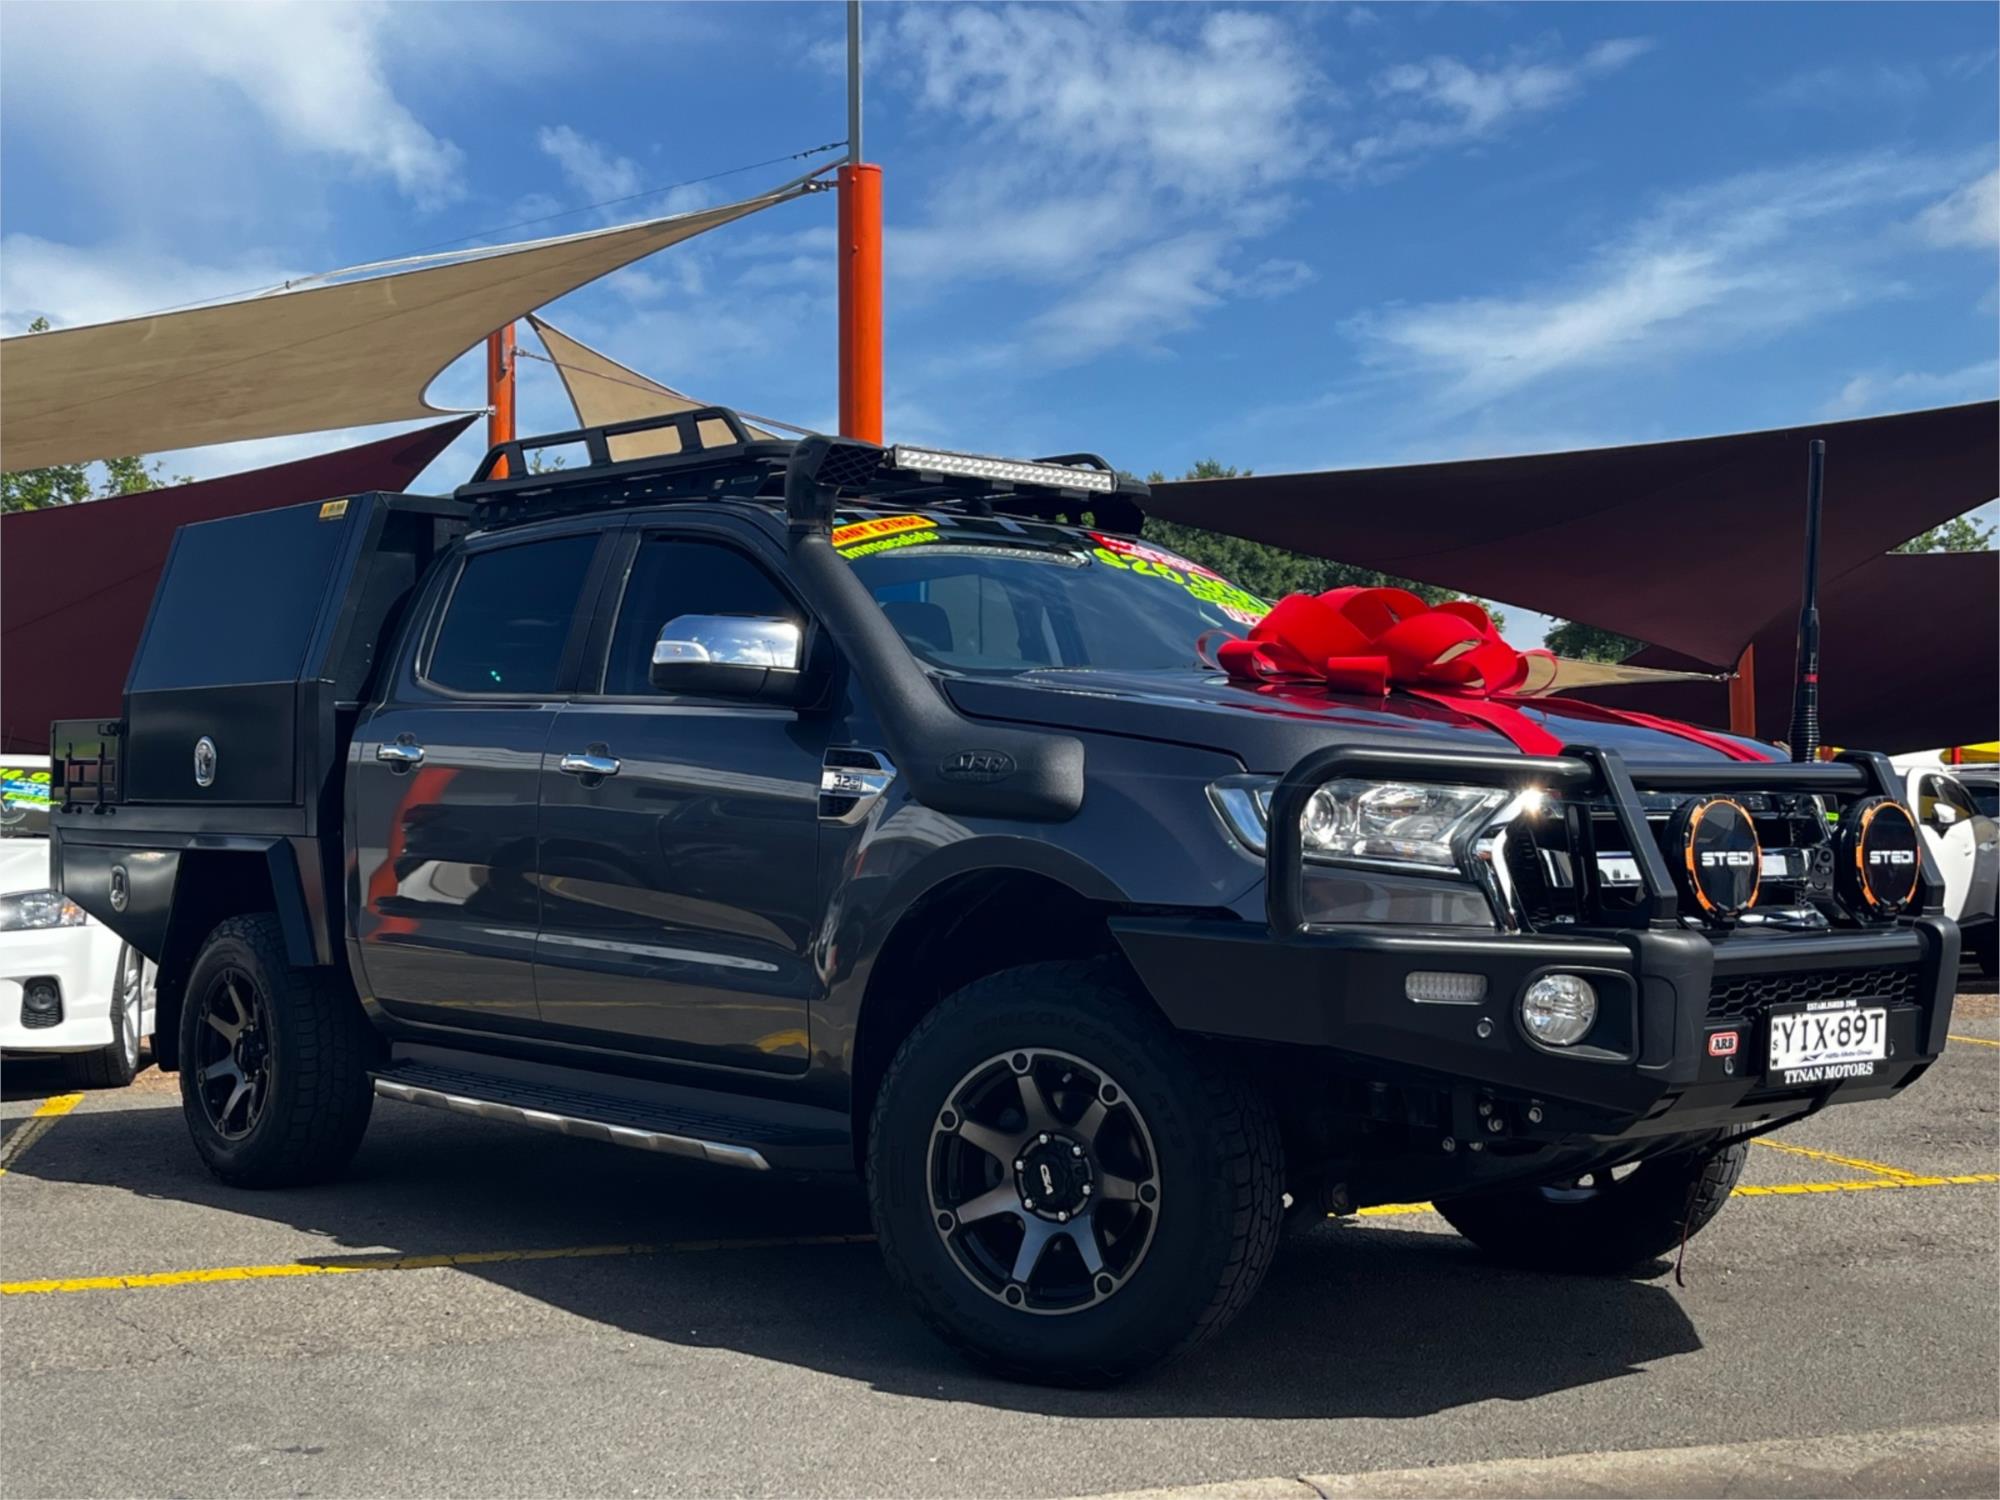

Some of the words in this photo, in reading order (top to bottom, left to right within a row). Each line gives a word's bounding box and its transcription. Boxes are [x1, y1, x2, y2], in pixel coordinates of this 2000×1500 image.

[836, 531, 939, 559] Immaculate
[1701, 851, 1754, 866] STEDI
[1869, 850, 1913, 864] STEDI
[1713, 1037, 1734, 1050] ARB
[1784, 1067, 1823, 1085] TYNAN
[1825, 1062, 1873, 1080] MOTORS
